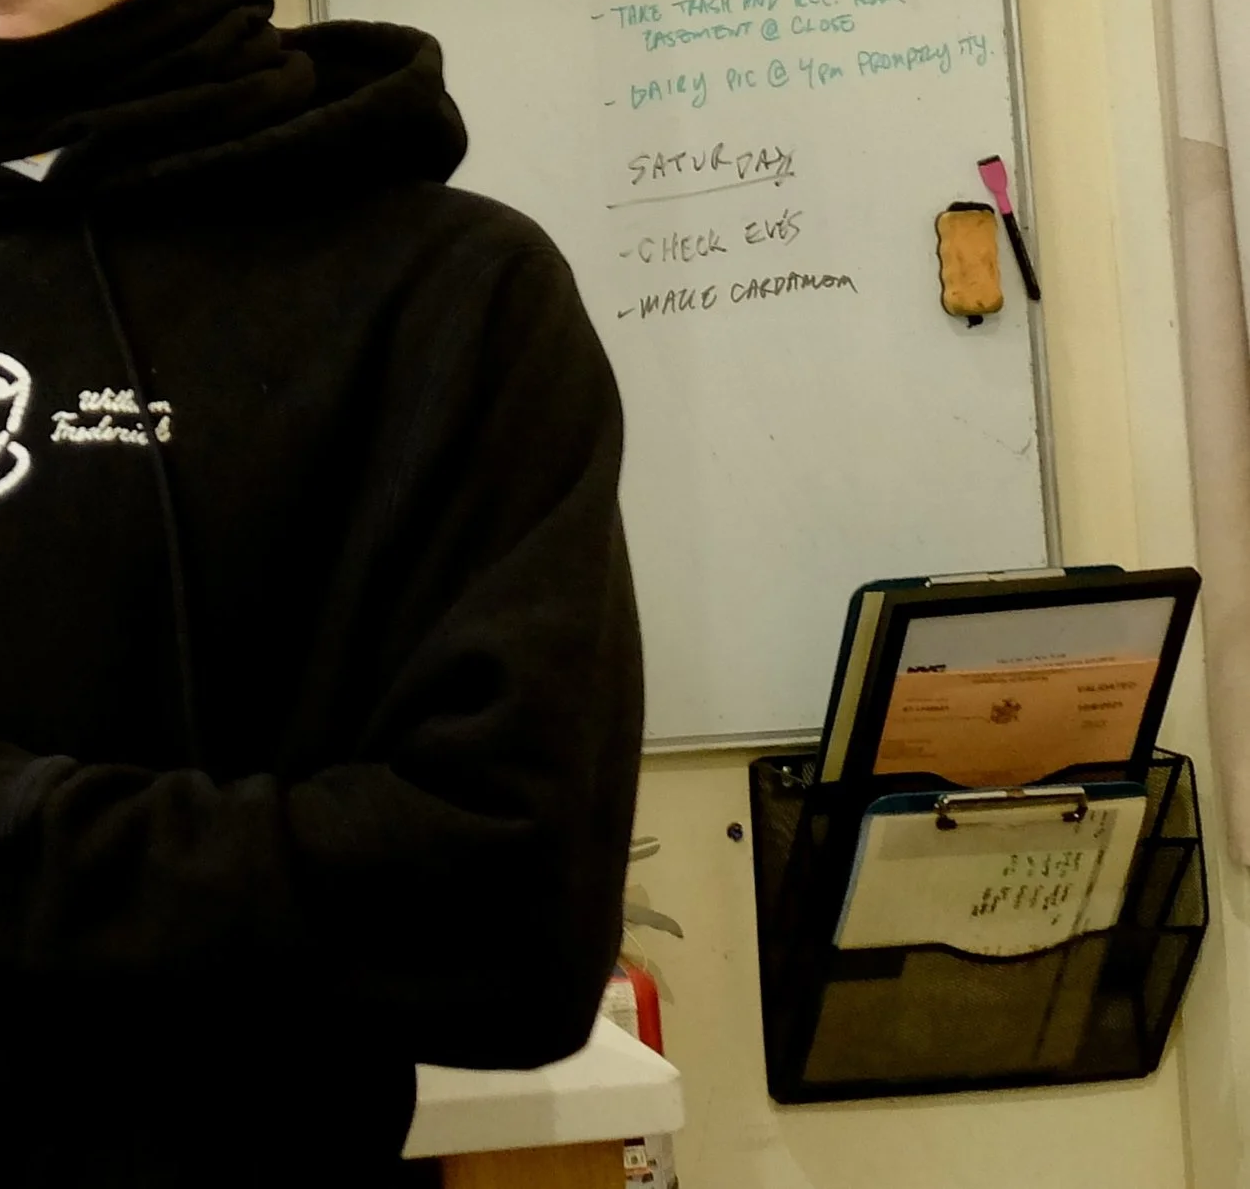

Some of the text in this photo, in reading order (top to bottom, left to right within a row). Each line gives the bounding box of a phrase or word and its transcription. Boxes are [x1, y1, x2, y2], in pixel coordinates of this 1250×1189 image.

[610, 4, 663, 30] TAKE
[760, 17, 782, 42] @
[790, 13, 856, 36] CLOSE
[630, 71, 708, 110] DAIRY
[767, 57, 791, 89] @
[637, 227, 728, 264] CHECK
[640, 270, 859, 320] MAKE CARDAMOM
